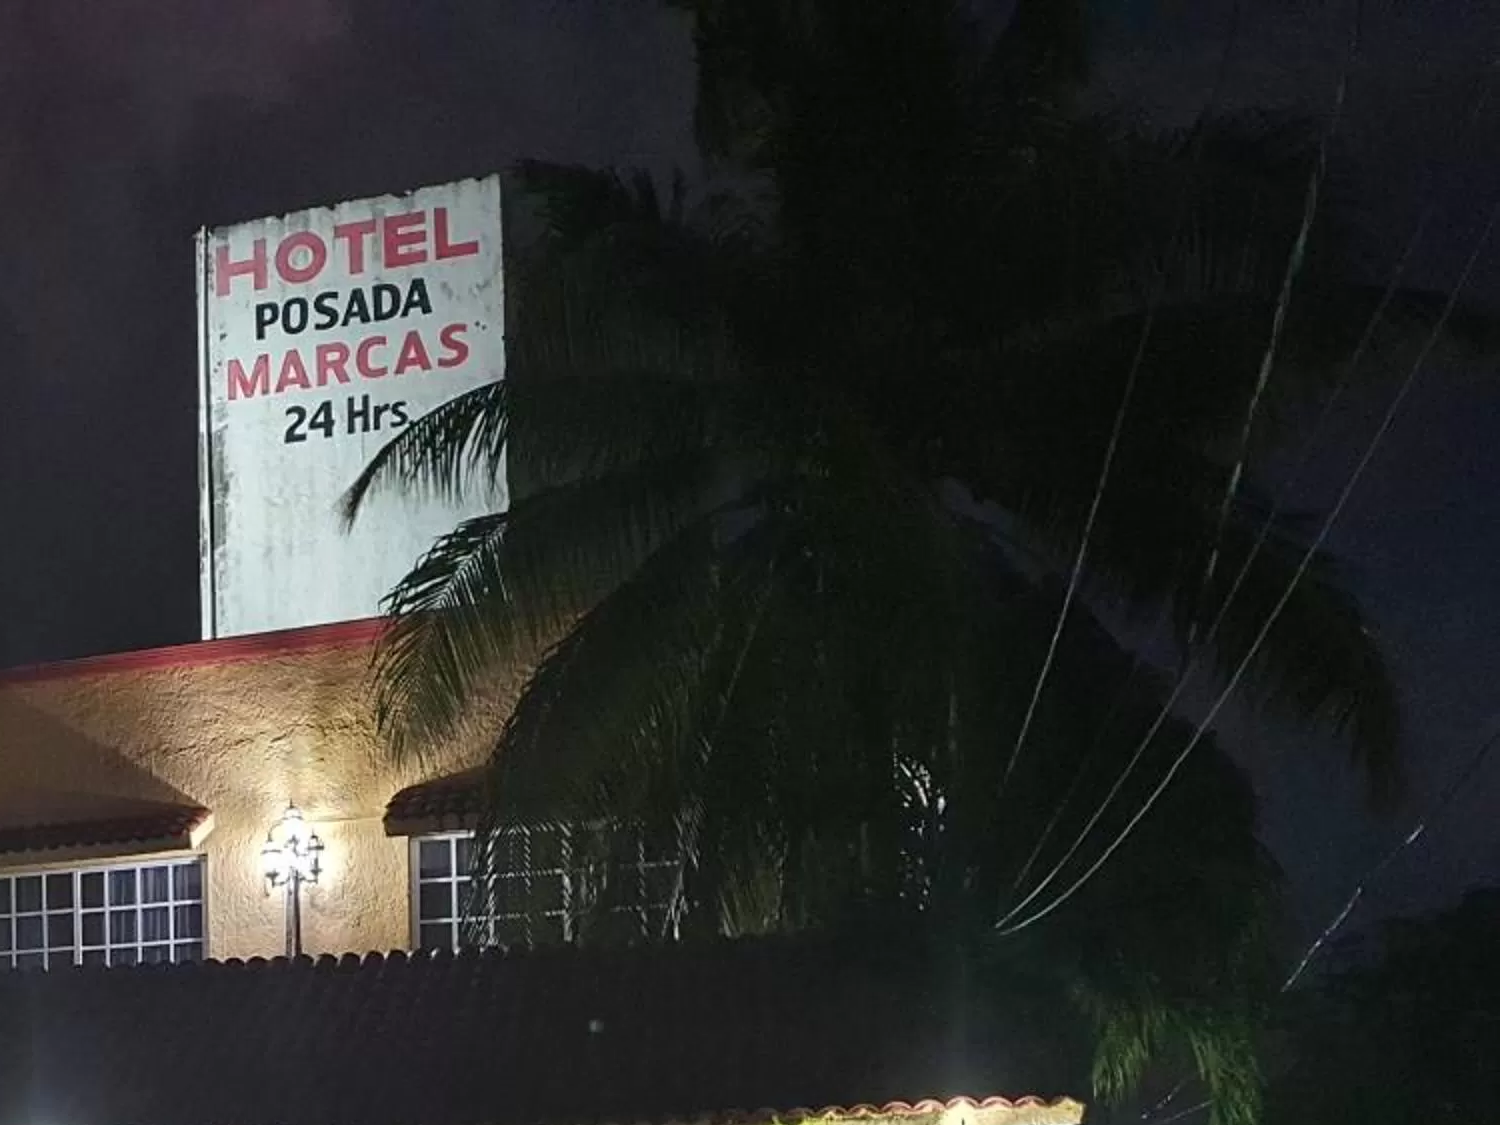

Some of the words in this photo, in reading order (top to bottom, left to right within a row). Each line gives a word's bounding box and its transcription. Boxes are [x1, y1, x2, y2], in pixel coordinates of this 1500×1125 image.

[215, 207, 479, 297] HOTEL
[255, 278, 432, 340] POSADA
[227, 323, 469, 401] MARCAS
[284, 400, 335, 444] 24
